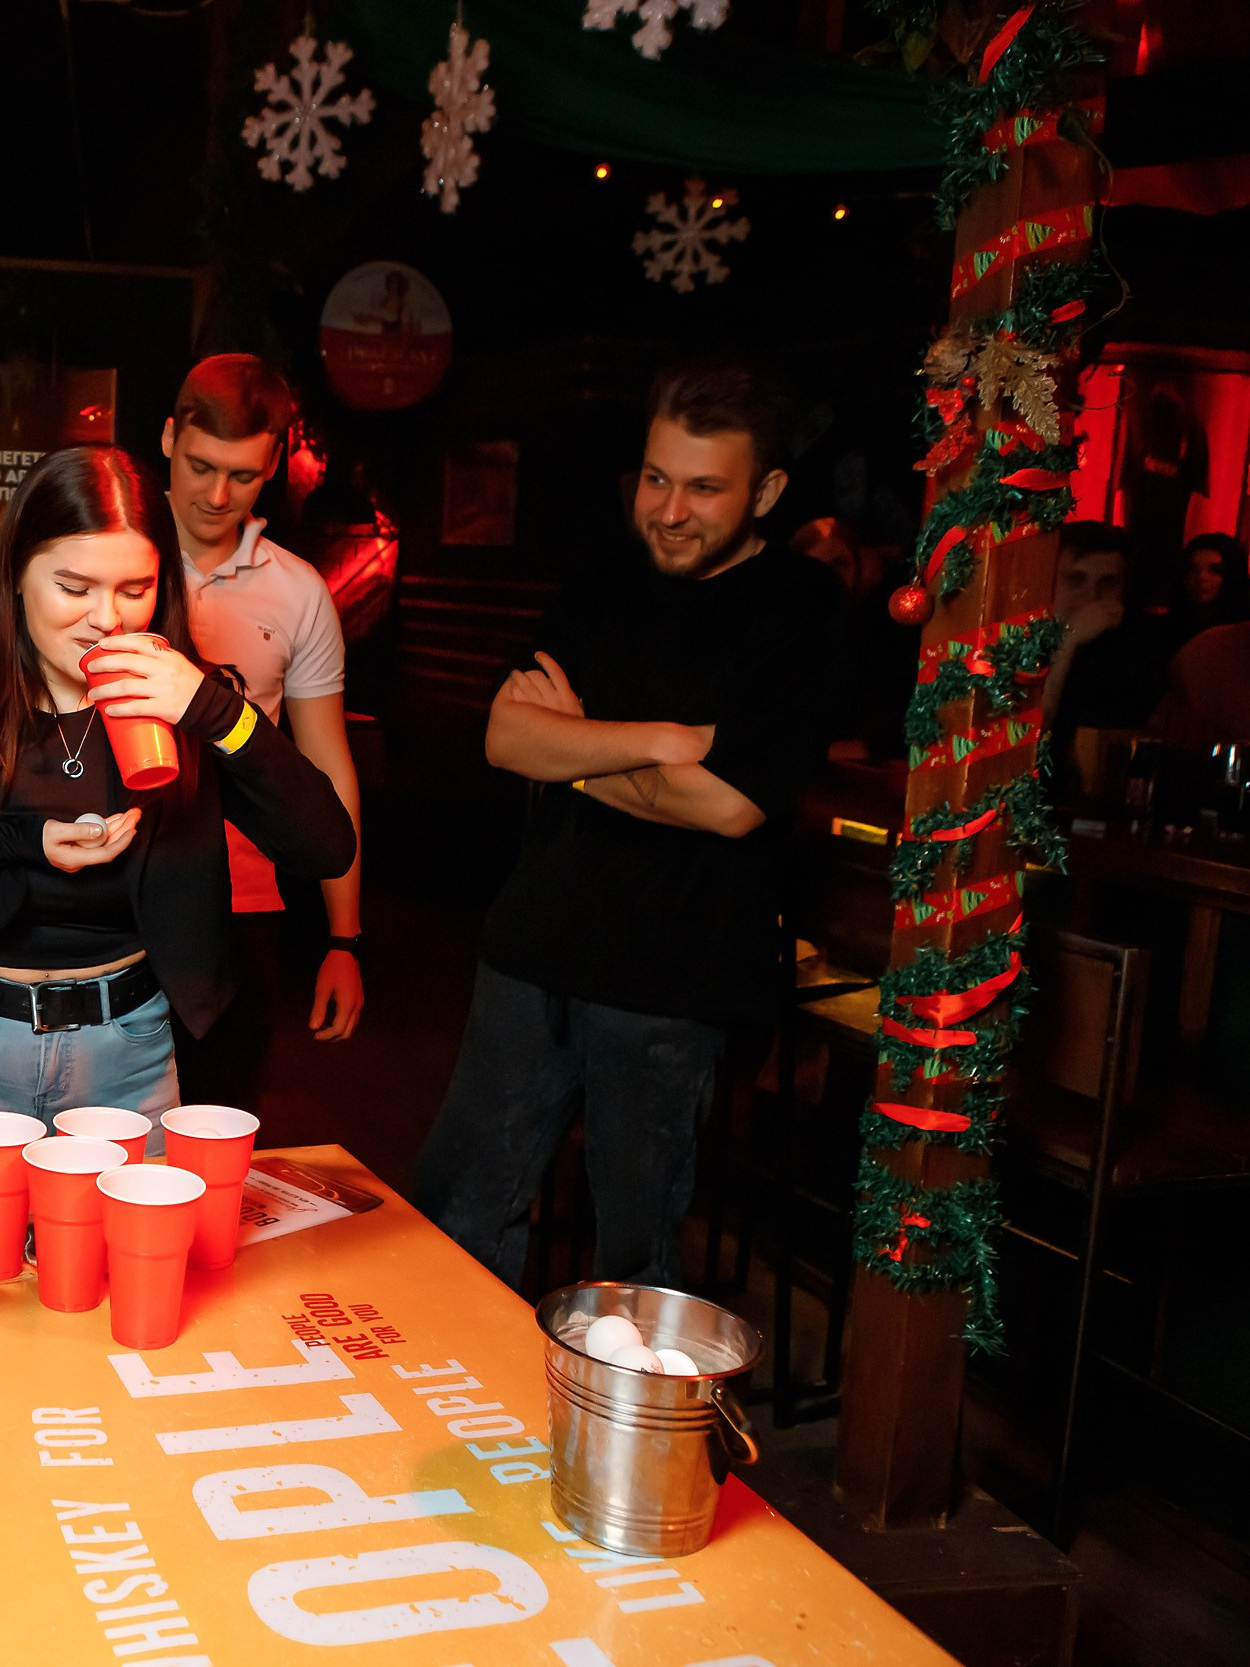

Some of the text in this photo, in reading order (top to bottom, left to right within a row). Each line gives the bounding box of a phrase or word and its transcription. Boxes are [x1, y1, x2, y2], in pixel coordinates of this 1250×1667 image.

[281, 1313, 331, 1350] PEOPLE
[299, 1293, 390, 1360] ARE GOOD
[347, 1303, 407, 1345] FOR YOU
[390, 1358, 551, 1486] PEOPLE
[31, 1406, 213, 1667] HISKEY FOR
[108, 1339, 617, 1667] OPLE
